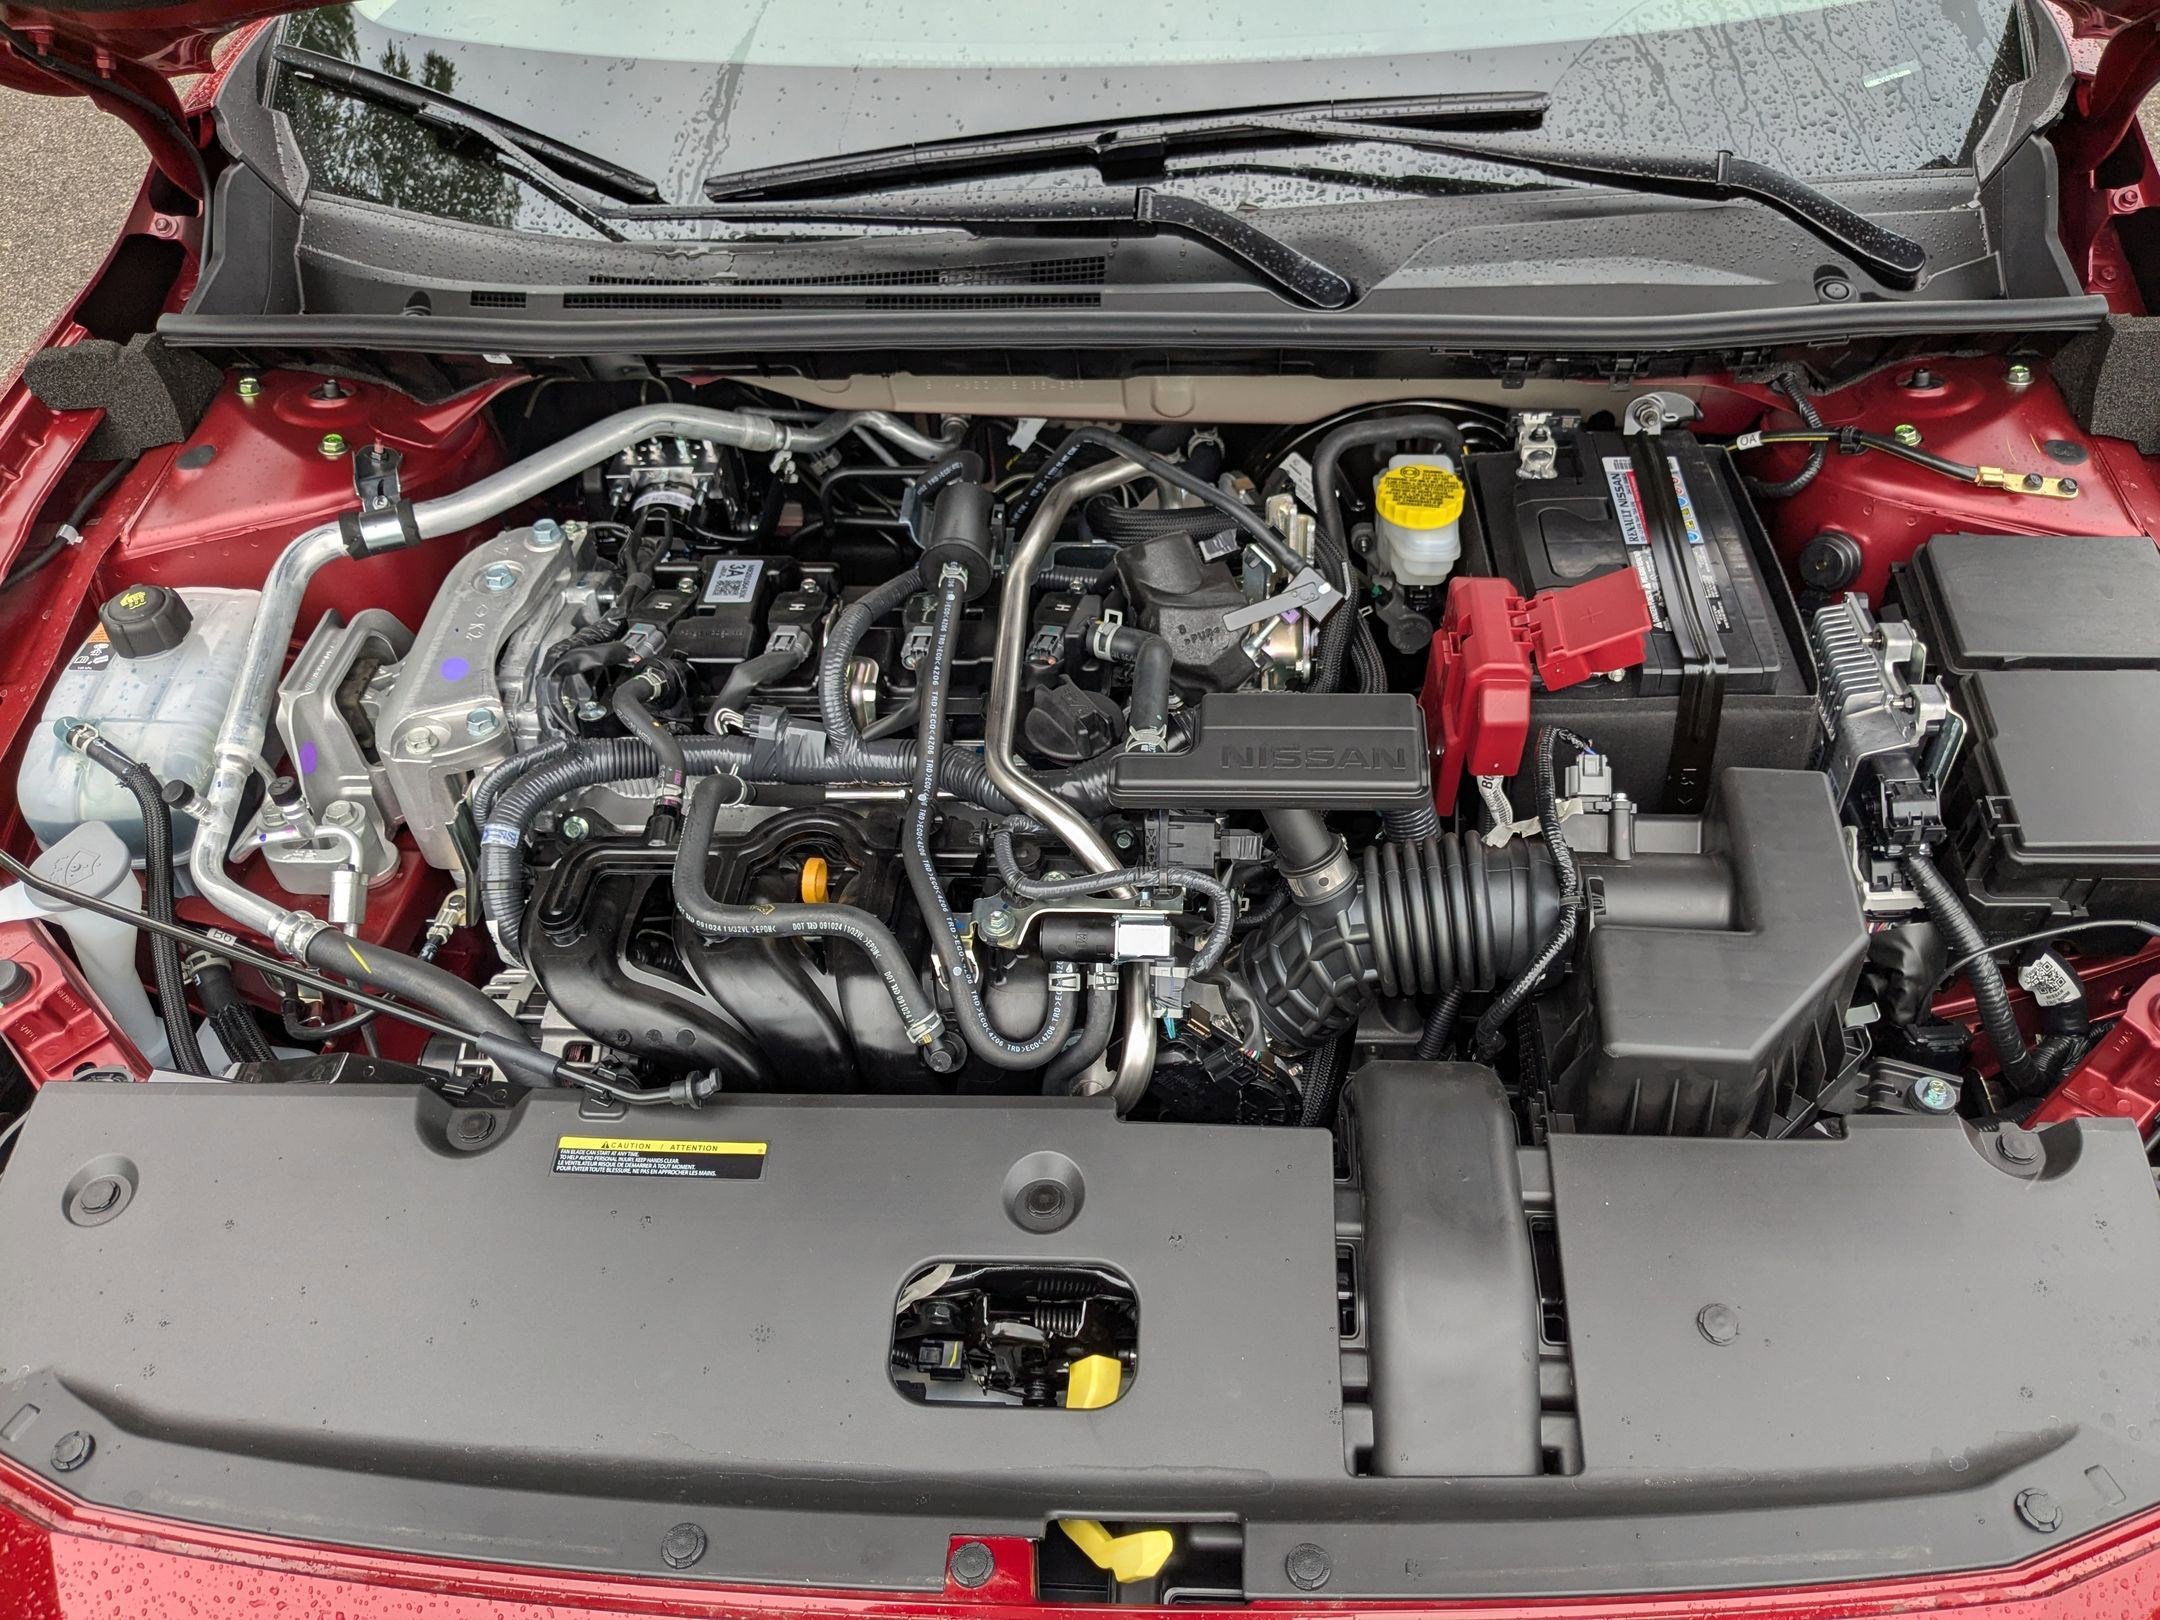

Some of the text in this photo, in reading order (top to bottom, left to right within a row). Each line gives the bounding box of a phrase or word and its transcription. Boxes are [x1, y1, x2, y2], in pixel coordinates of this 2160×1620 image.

[1610, 472, 1629, 508] NISSAN
[1621, 510, 1640, 542] RENAULT
[726, 564, 746, 577] 3A
[1221, 747, 1406, 770] NISSAN
[696, 920, 722, 932] 091024
[792, 922, 805, 931] DOT
[820, 921, 843, 931] 091024
[896, 995, 912, 1020] 091024
[611, 1142, 651, 1150] CAUTION
